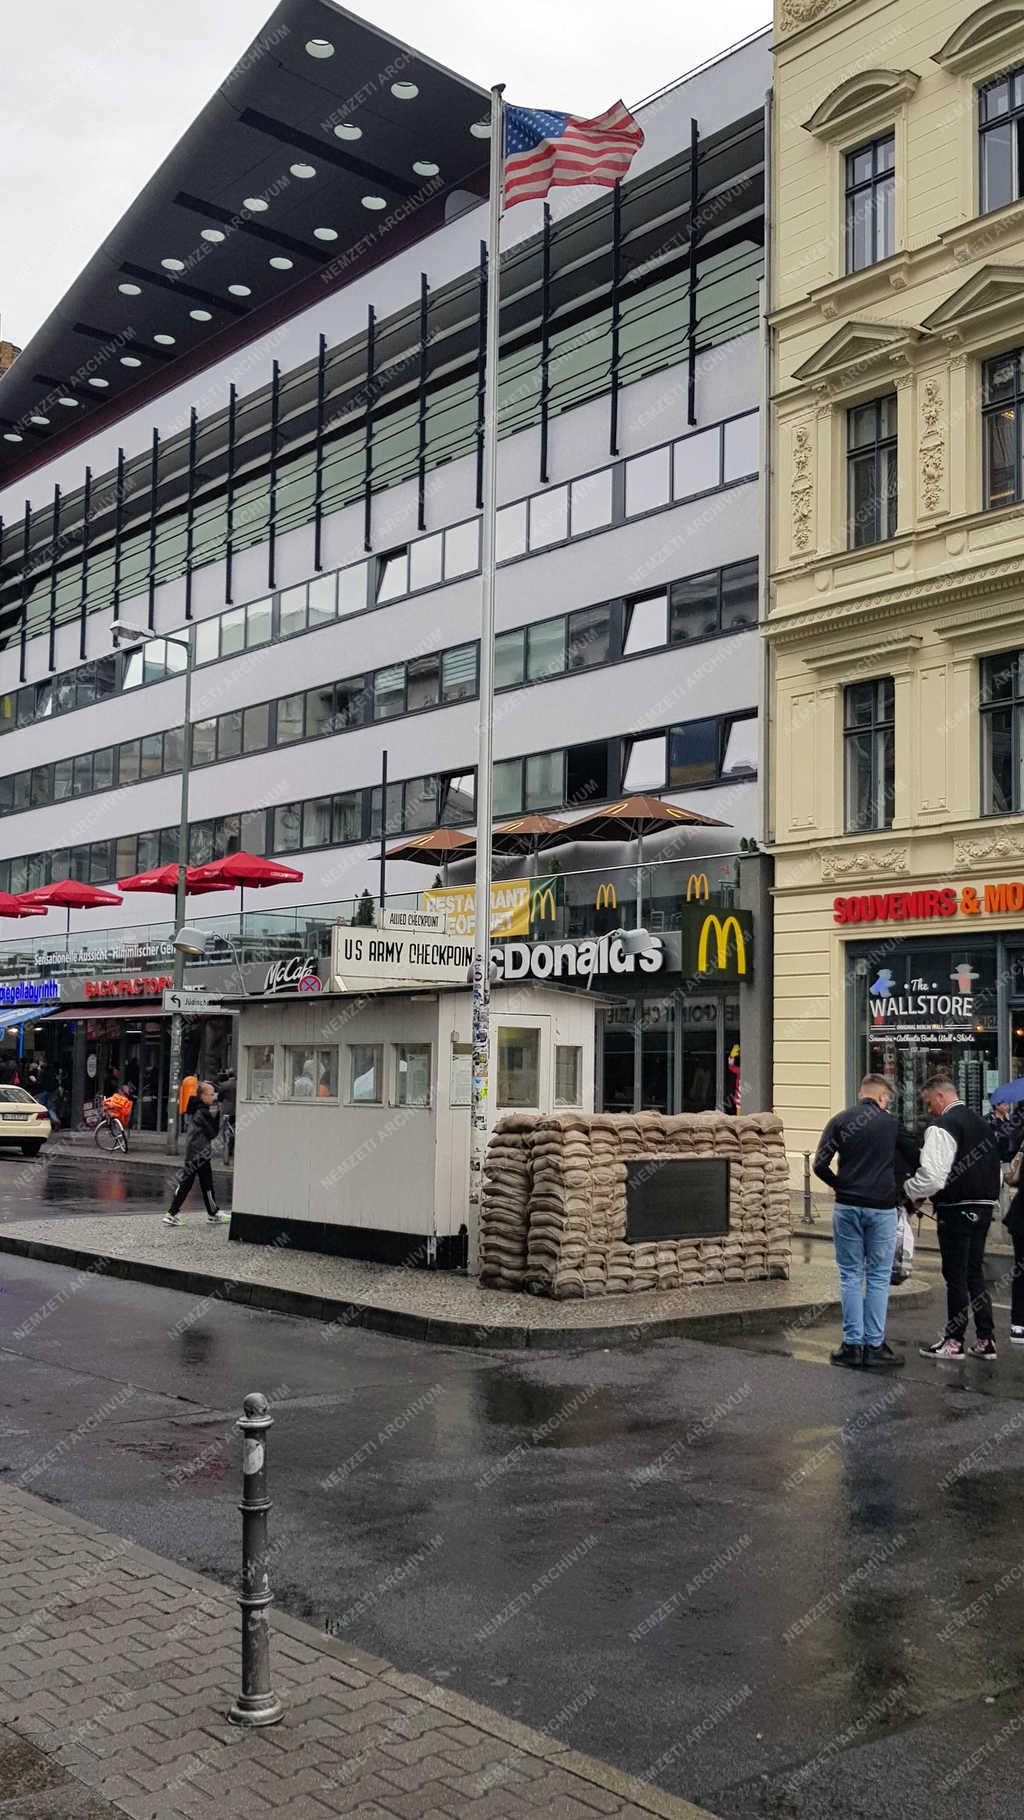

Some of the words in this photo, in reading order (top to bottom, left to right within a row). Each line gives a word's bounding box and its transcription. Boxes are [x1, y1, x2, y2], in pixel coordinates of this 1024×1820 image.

[425, 888, 527, 913] RESTAANT
[833, 888, 958, 924] SOUVENIRS
[960, 886, 981, 914] &
[389, 912, 407, 926] ALLIED
[408, 913, 439, 928] CHECKPOINT
[368, 939, 404, 963] ARMY
[409, 943, 475, 967] CHECKPOIN
[911, 978, 929, 991] The
[870, 995, 974, 1017] WALLSTORE
